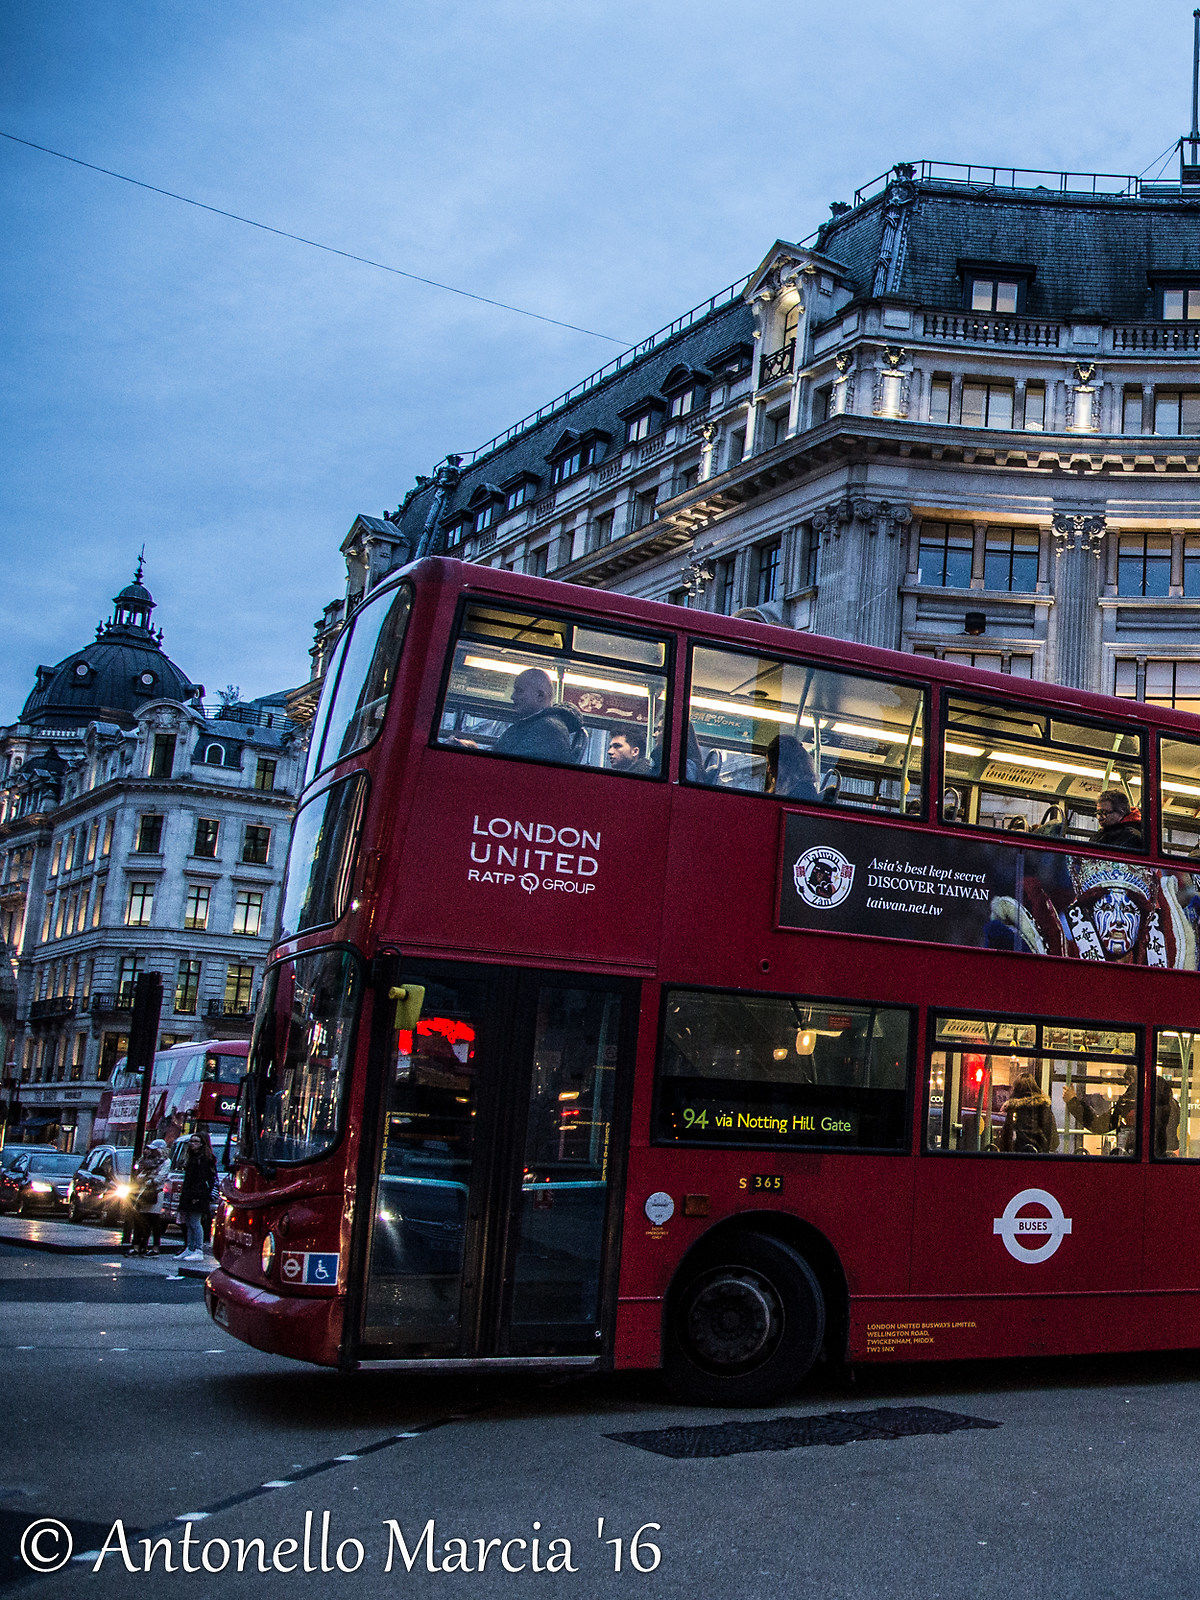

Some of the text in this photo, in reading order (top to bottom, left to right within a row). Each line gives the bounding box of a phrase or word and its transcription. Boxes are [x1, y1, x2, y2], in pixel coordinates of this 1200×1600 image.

[472, 815, 601, 850] LONDON
[470, 841, 599, 876] UNITED
[867, 857, 903, 873] Asia's
[904, 861, 927, 876] best
[928, 864, 952, 880] kept
[953, 869, 986, 884] secret
[467, 869, 596, 895] RATP GROUP
[867, 874, 990, 901] DISCOVER TAIWAN
[866, 896, 943, 916] taiwan.net.tw
[683, 1108, 851, 1134] 94 via Notting Hill Gate
[739, 1176, 782, 1189] S 365
[1018, 1221, 1048, 1231] BUSES
[866, 1330, 909, 1338] WELLINGTON
